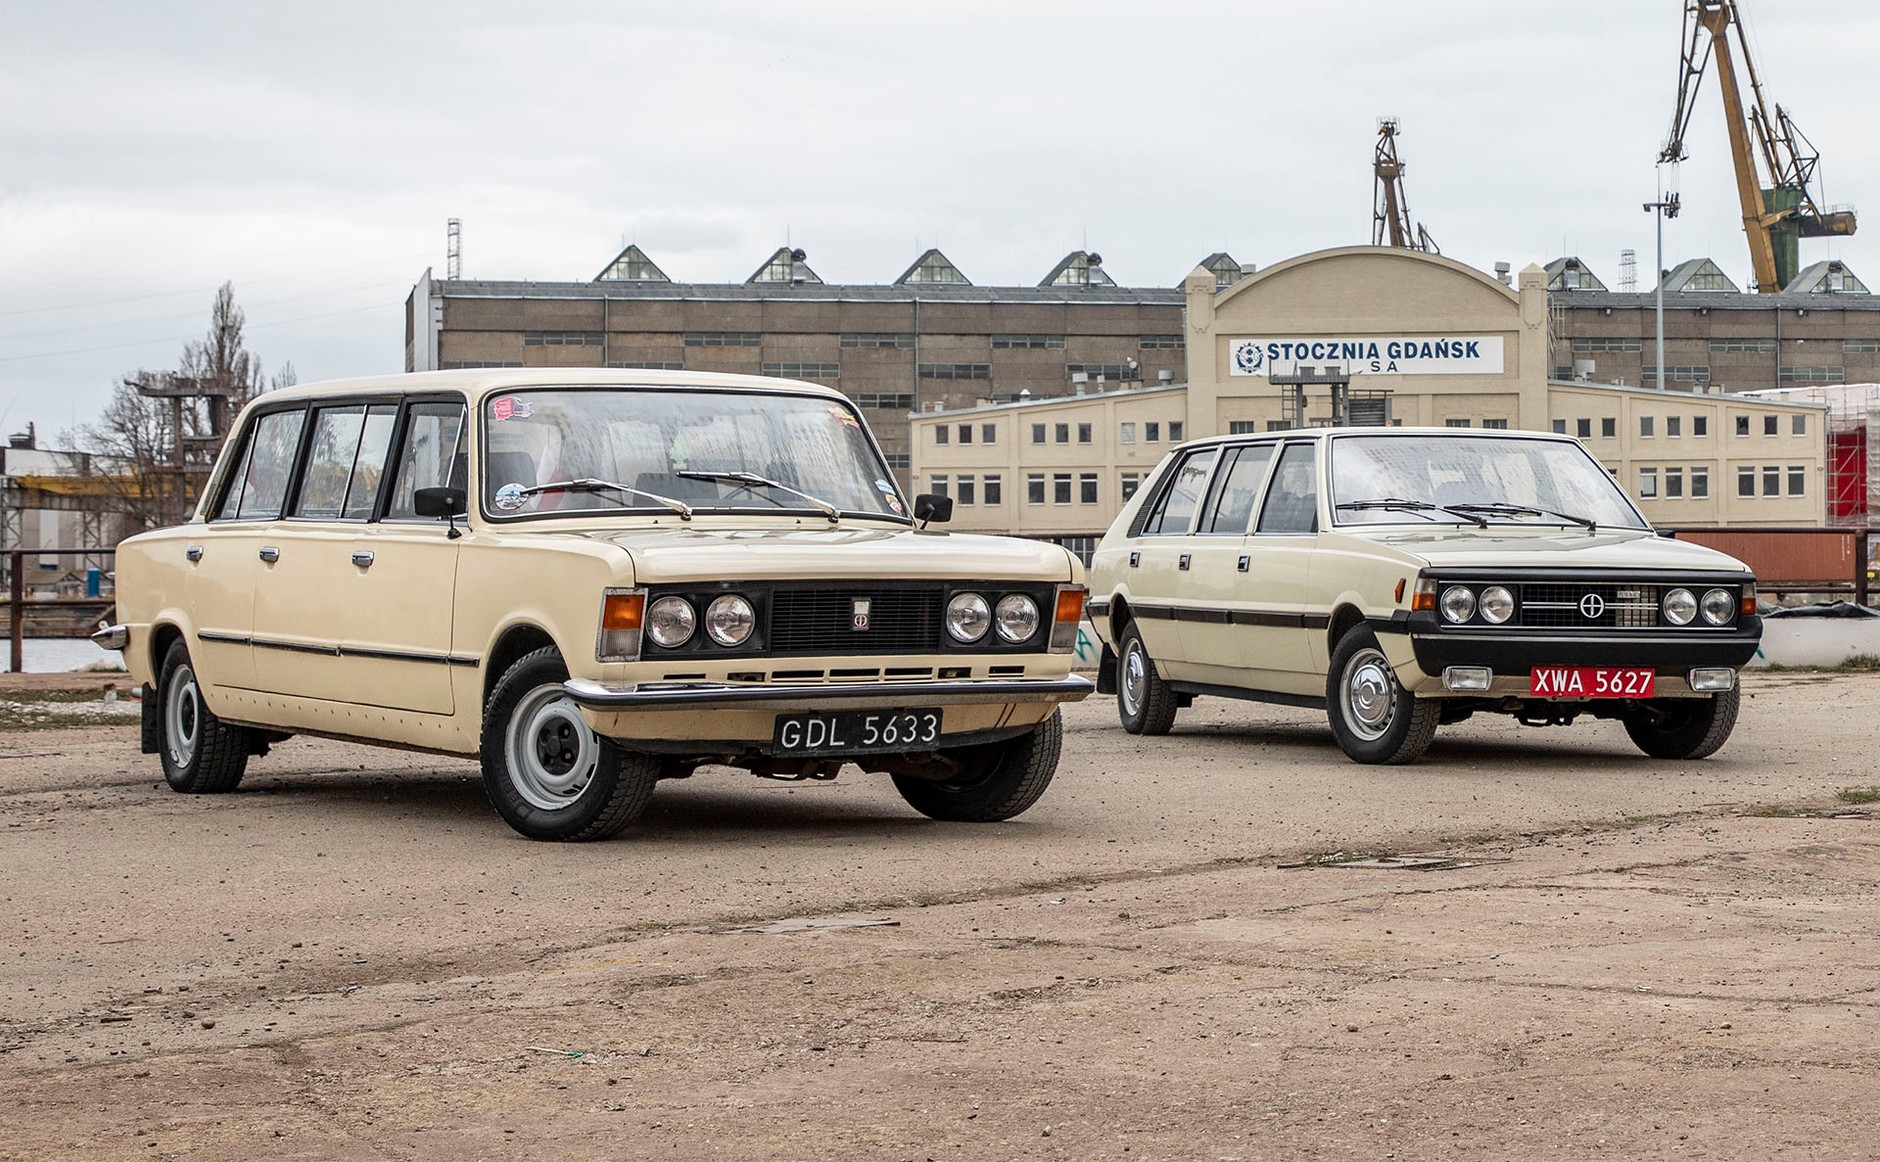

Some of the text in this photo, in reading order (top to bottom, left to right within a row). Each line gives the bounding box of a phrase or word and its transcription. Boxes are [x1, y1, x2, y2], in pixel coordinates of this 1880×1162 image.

[1267, 338, 1480, 360] STOCZNIA GDAŃSK
[1534, 669, 1652, 694] XWA 5627
[781, 714, 938, 748] GDL 5633
